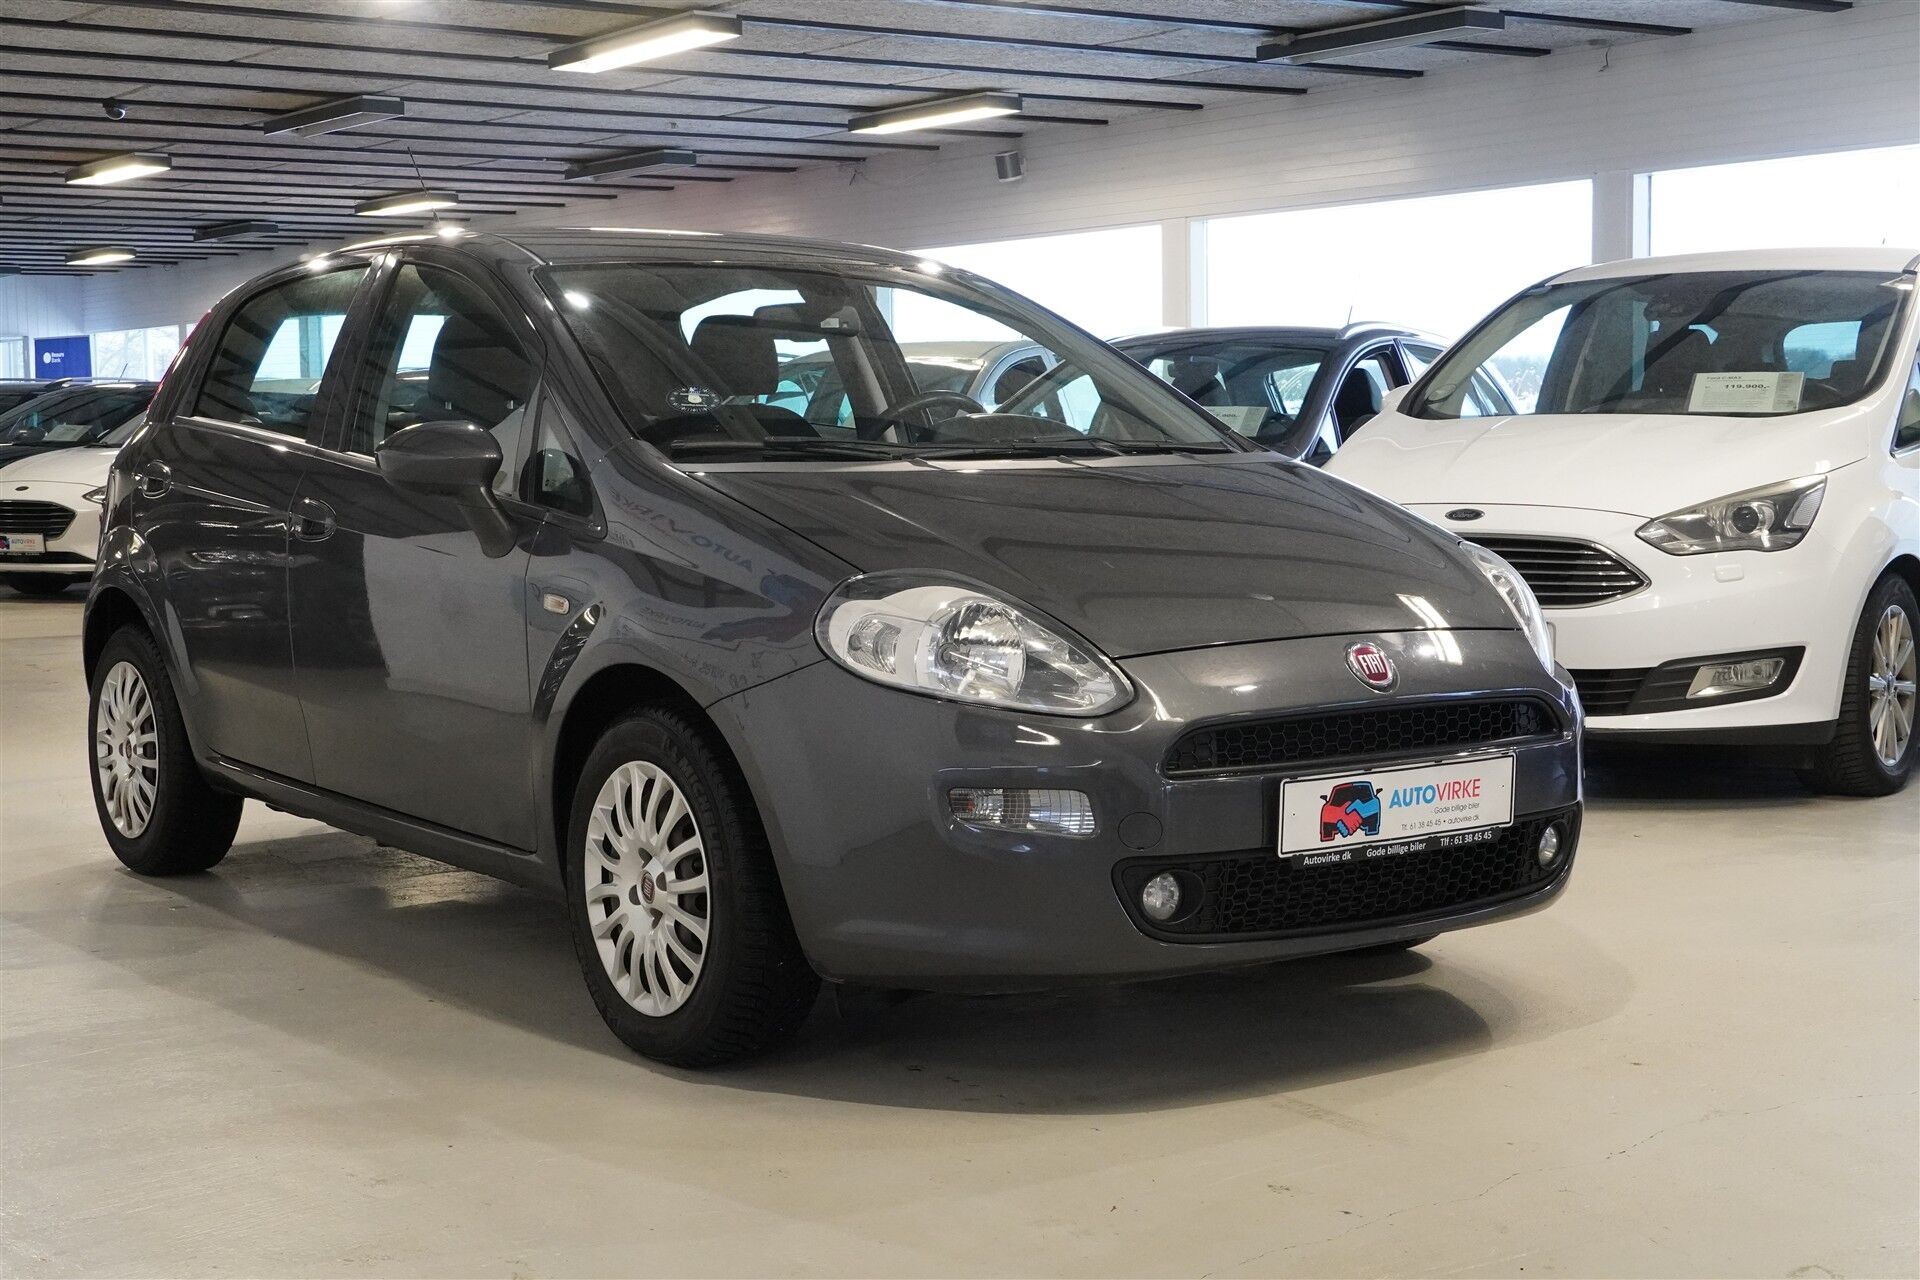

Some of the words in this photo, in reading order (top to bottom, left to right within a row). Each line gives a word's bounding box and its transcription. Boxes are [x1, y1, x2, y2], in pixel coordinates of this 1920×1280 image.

[1357, 653, 1386, 675] FIAT
[1389, 779, 1481, 809] AUTOVIRKE
[1433, 805, 1450, 814] Gode
[1451, 803, 1467, 813] billige
[1468, 802, 1480, 810] biler
[1409, 822, 1416, 830] 61
[1434, 818, 1441, 826] 45
[1366, 847, 1386, 857] Gode
[1387, 845, 1409, 855] billige
[1410, 842, 1427, 851] biler
[1454, 835, 1462, 845] 61
[1464, 834, 1473, 843] 38
[1474, 832, 1482, 841] 45
[1483, 830, 1492, 839] 45
